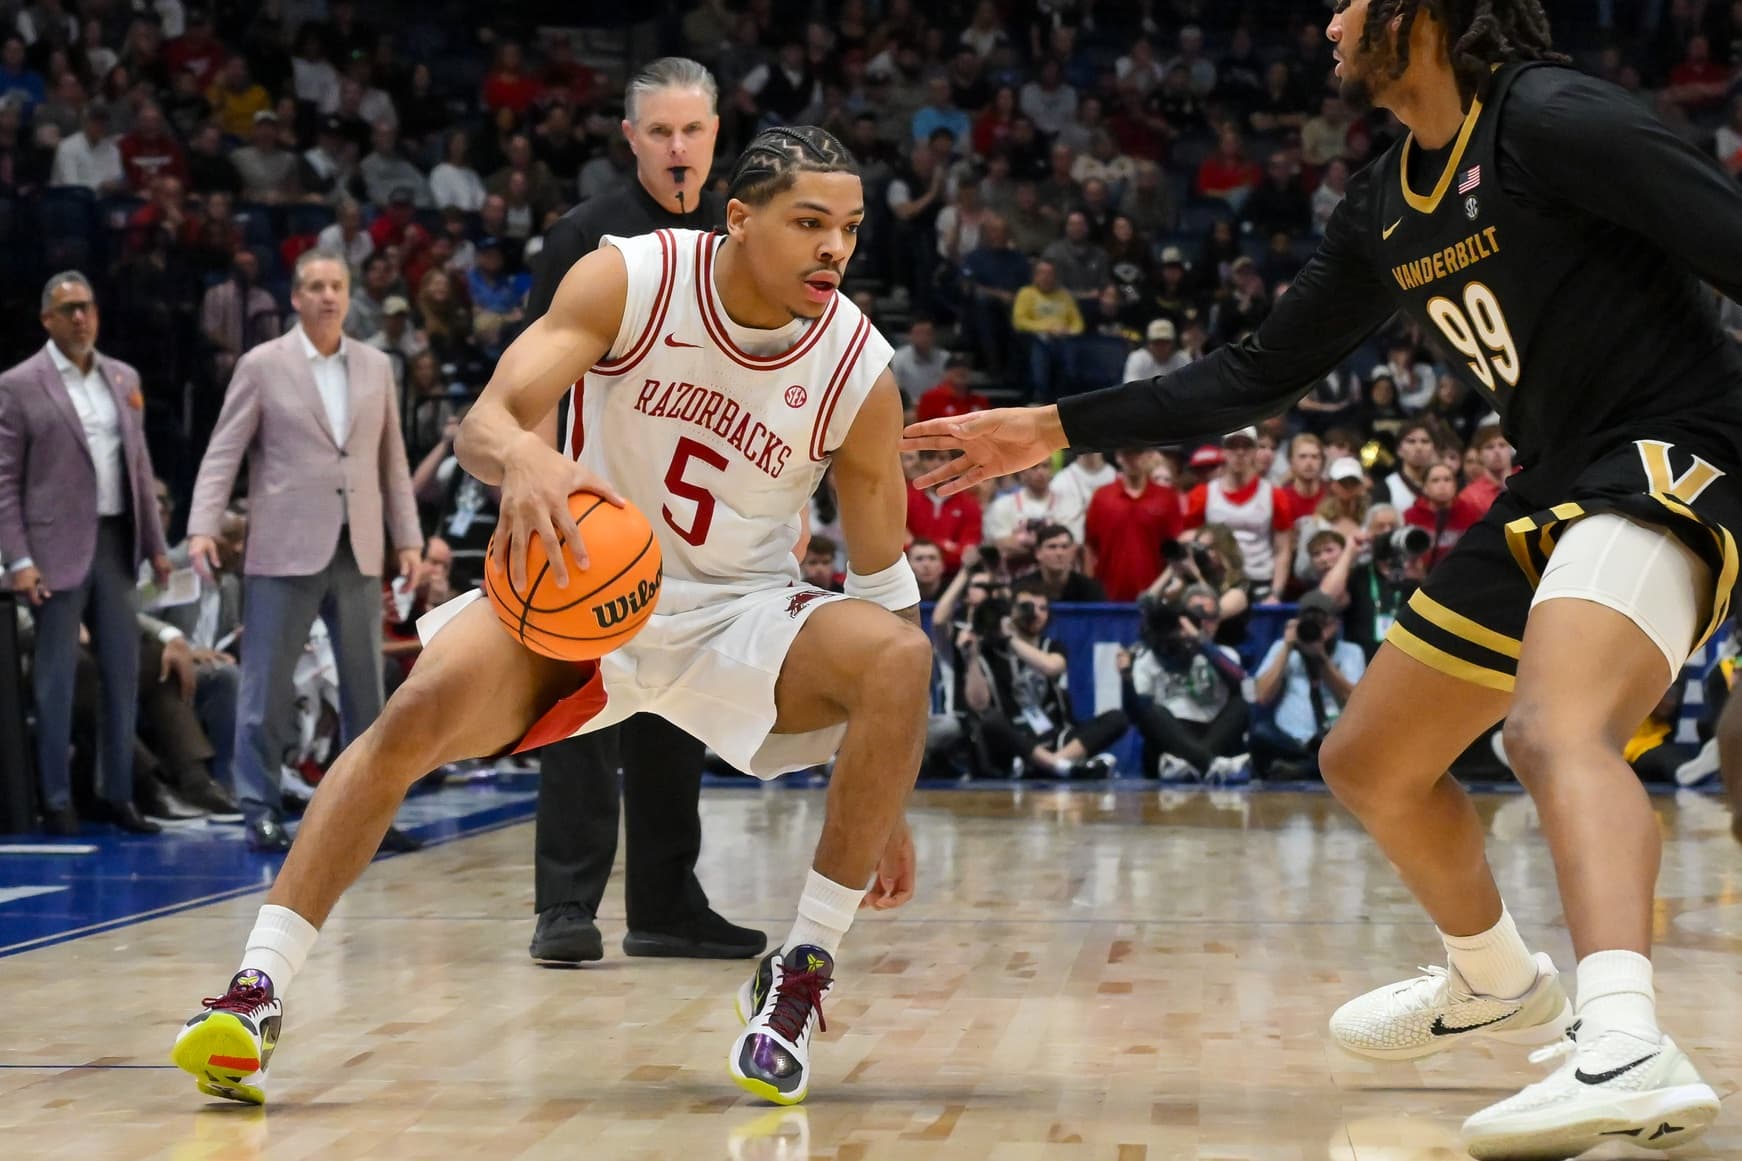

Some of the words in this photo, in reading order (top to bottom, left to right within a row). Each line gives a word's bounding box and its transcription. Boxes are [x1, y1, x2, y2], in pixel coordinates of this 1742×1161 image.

[1392, 226, 1500, 290] VANDERBILT
[1426, 281, 1520, 392] 99
[634, 379, 792, 479] RAZORBACKS
[662, 436, 729, 546] 5
[1632, 439, 1727, 505] V
[592, 567, 663, 628] Wilso
